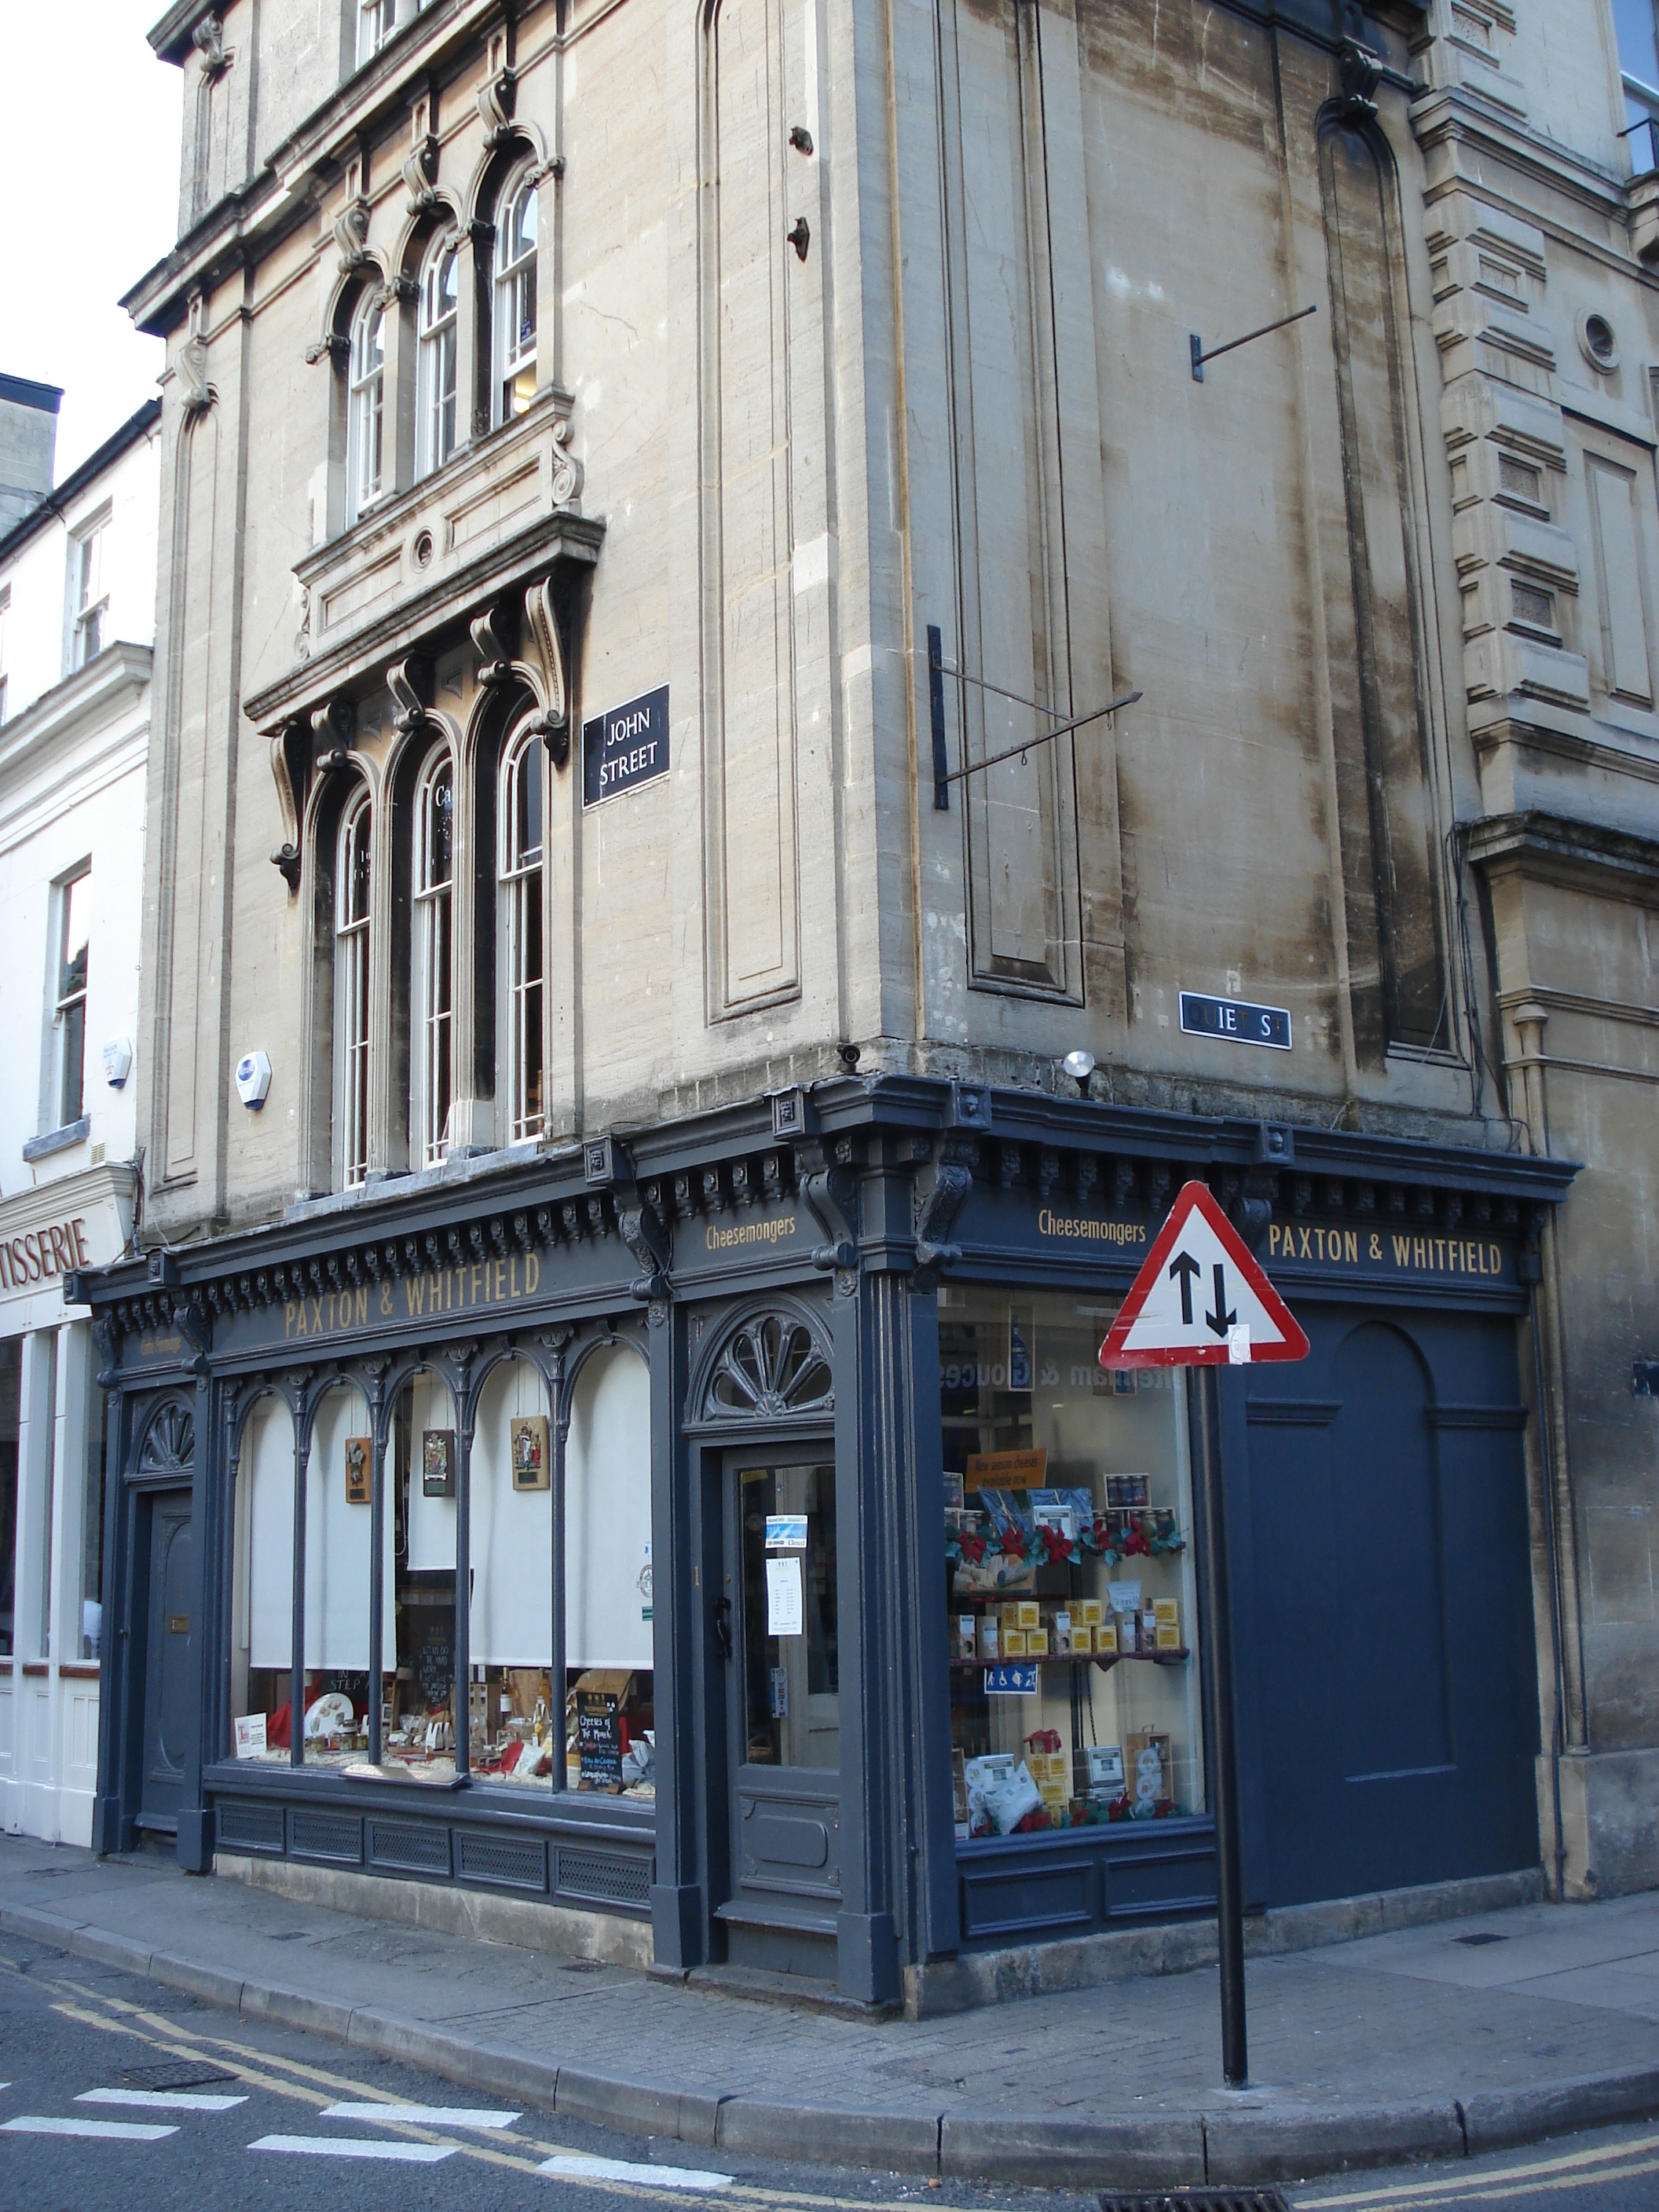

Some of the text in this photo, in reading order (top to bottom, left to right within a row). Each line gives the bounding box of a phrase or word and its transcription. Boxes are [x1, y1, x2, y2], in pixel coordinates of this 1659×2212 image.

[606, 708, 650, 747] JOHN
[599, 741, 658, 786] STREET
[1188, 1002, 1284, 1039] QUIET ST
[706, 1217, 796, 1250] Cheesemongers
[1038, 1209, 1146, 1246] Cheesemongers
[1269, 1224, 1502, 1275] PAXTON & WHITFIELD
[285, 1252, 539, 1338] PAXTON & WHITFIELD
[1014, 1455, 1038, 1469] cheeses
[329, 1679, 361, 1691] STEP
[580, 1715, 602, 1728] Cheeses
